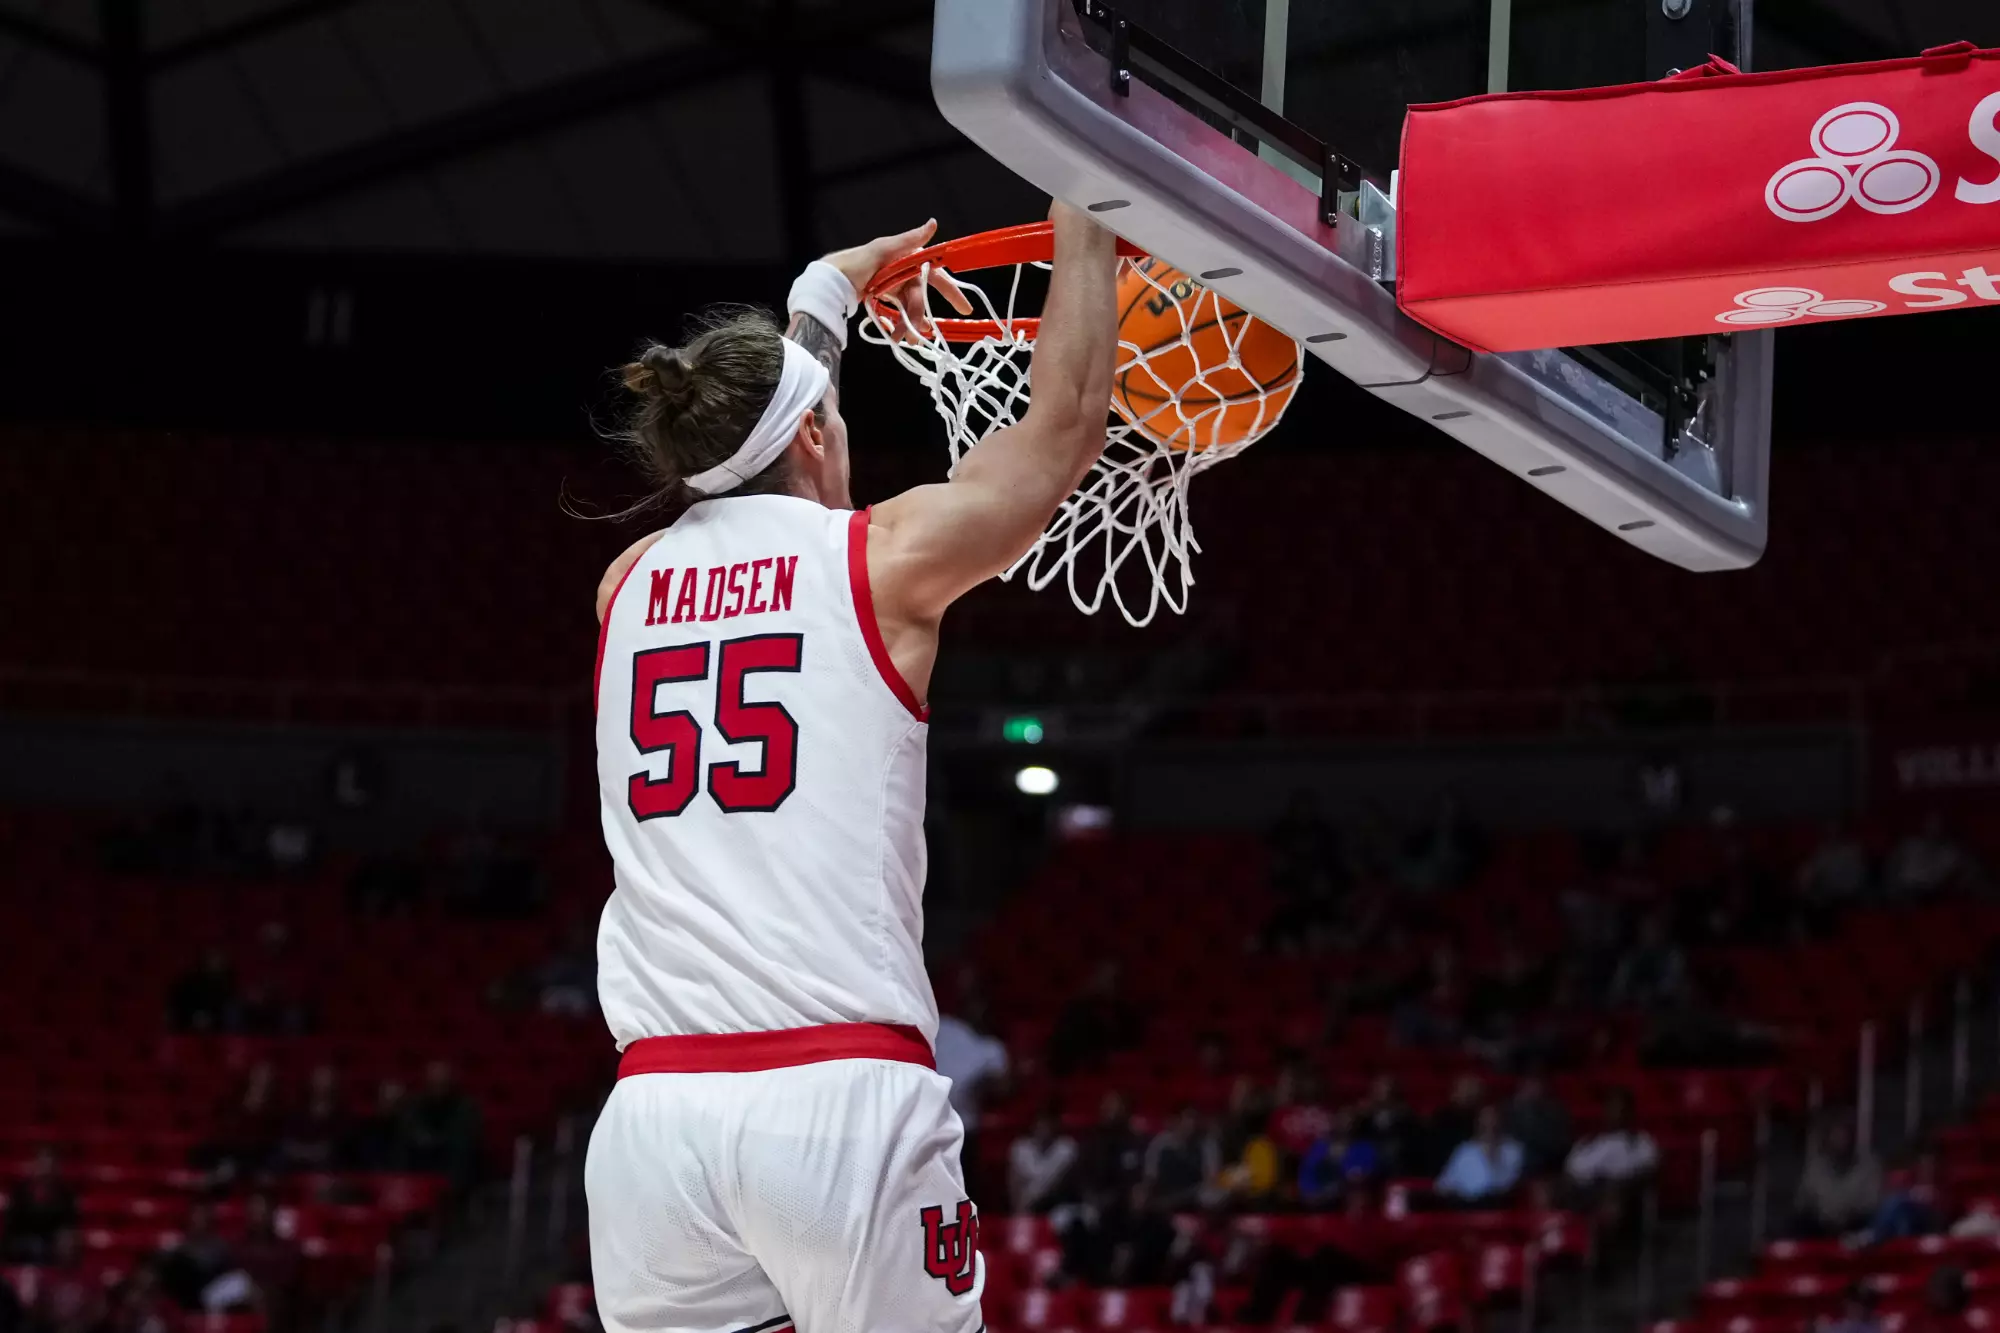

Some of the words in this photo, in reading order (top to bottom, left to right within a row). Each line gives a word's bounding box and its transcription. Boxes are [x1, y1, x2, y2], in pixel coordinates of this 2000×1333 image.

[1888, 266, 2000, 308] St
[645, 555, 799, 626] MADSEN
[628, 633, 804, 823] 55
